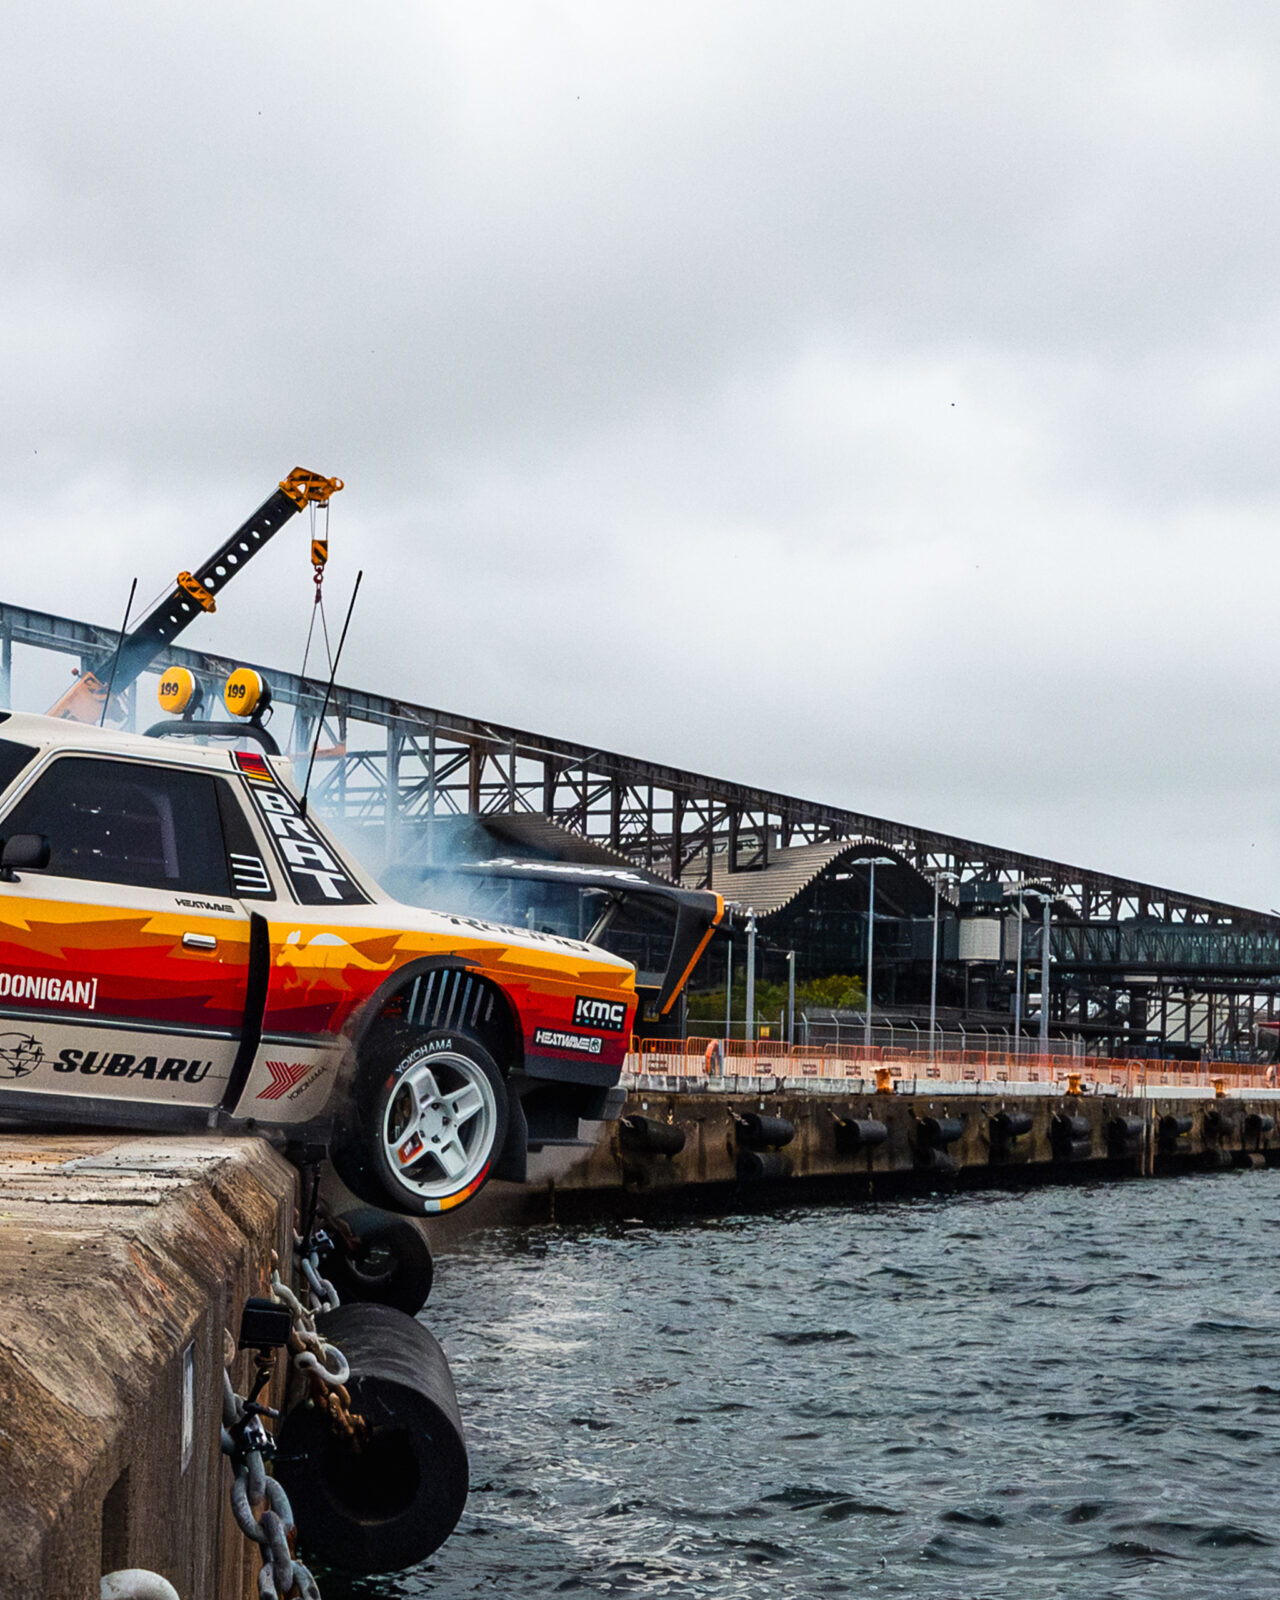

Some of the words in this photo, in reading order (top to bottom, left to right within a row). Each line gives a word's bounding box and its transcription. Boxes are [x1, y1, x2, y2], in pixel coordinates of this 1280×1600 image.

[161, 682, 179, 696] 199
[227, 684, 246, 698] 199
[253, 789, 347, 900] BRAT
[576, 999, 624, 1022] KMC
[536, 1030, 590, 1050] HEATWAVE
[53, 1049, 212, 1084] SUBARU
[395, 1038, 453, 1075] YOKOHAMA
